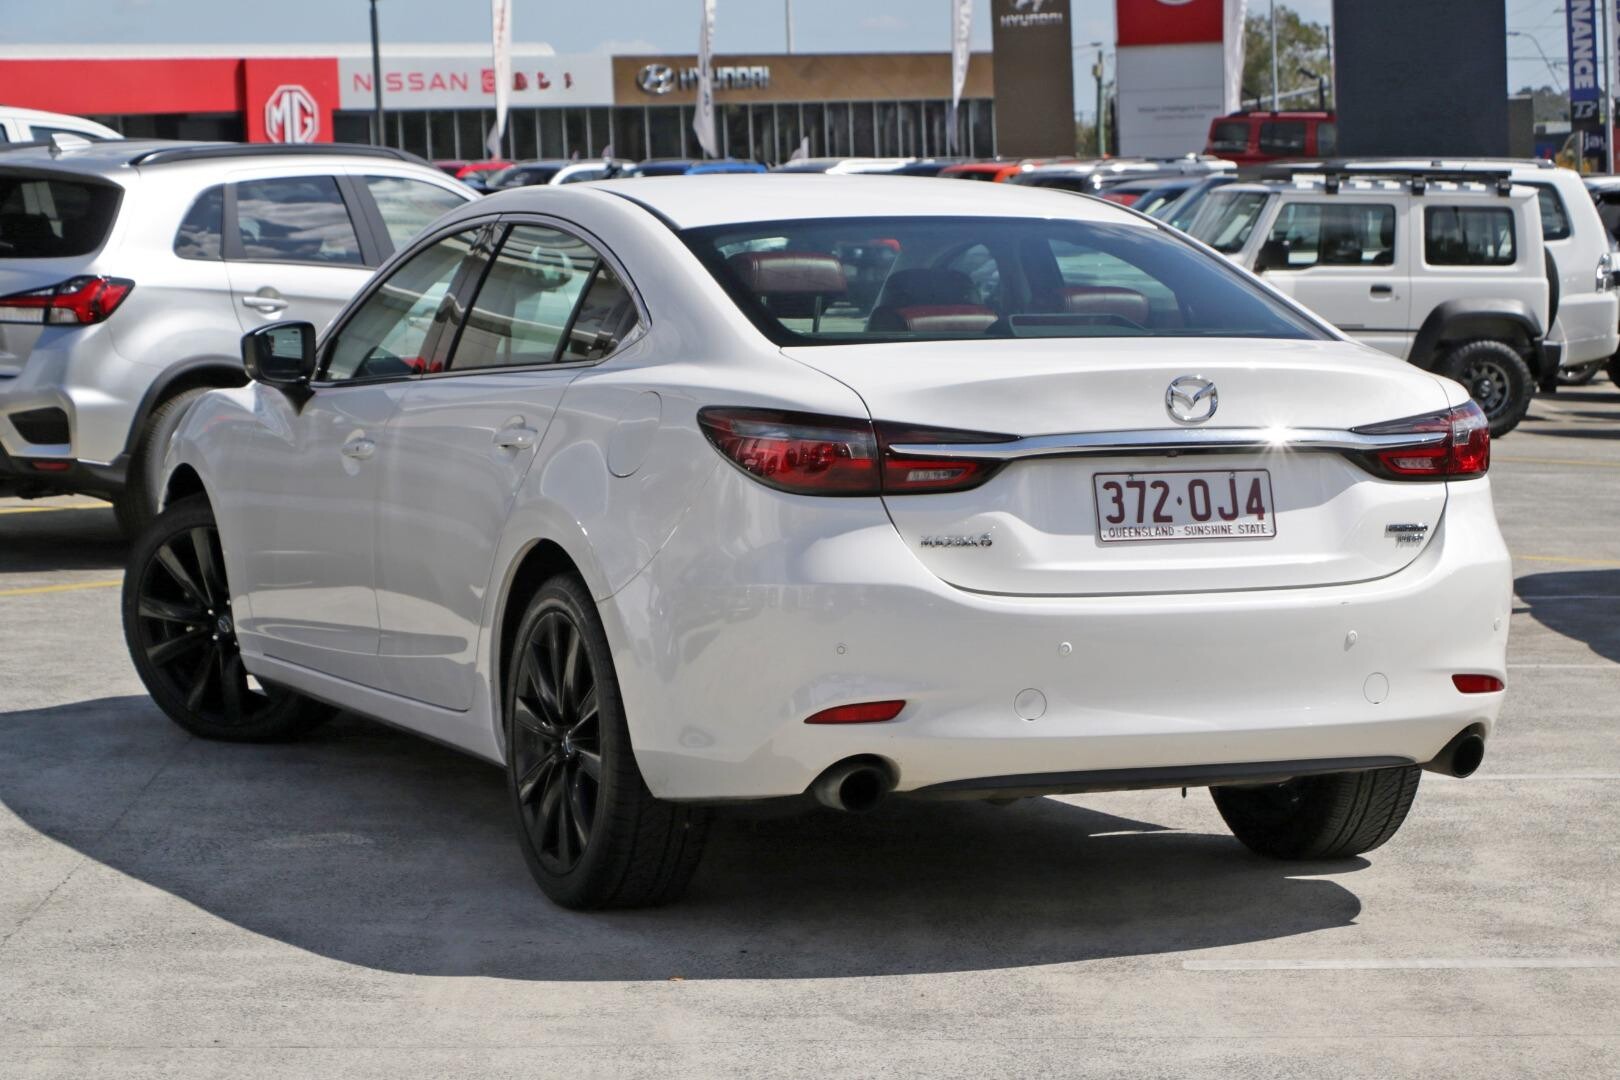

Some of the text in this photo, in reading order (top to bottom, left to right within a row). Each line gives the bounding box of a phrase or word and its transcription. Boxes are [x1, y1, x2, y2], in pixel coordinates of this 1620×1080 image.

[1000, 12, 1063, 27] HYUNDAI
[352, 72, 469, 92] NSSAN
[679, 65, 770, 90] HUNDAI
[269, 87, 317, 143] MG
[1108, 523, 1267, 538] QUEENSLAND SUNSHINE STATE
